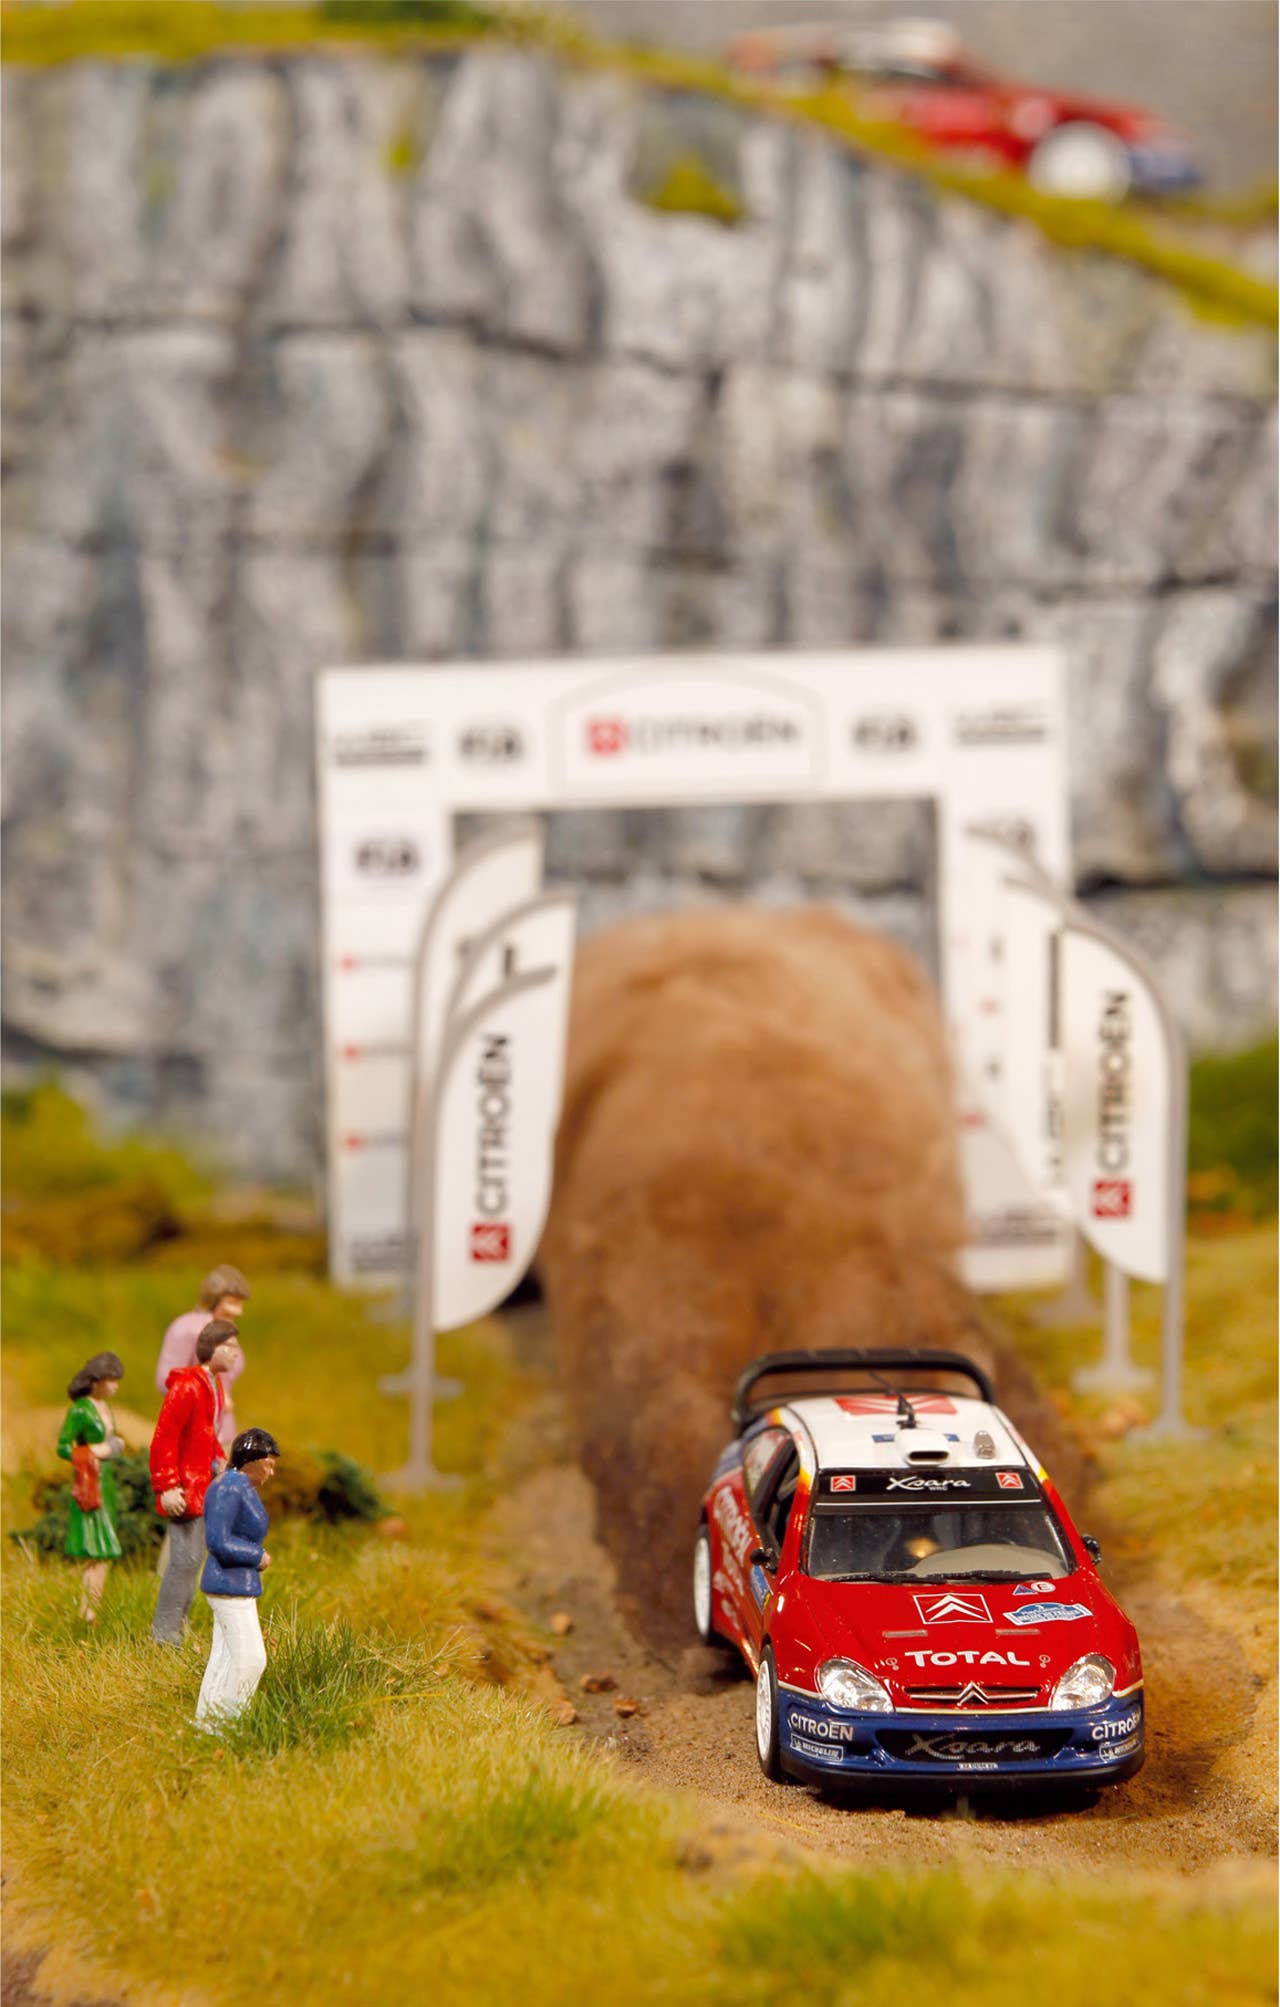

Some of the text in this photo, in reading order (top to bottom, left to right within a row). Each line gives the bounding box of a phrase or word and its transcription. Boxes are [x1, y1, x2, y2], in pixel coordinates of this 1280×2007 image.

[886, 1476, 971, 1491] Xsara
[904, 1650, 1031, 1667] TOTAL
[904, 1733, 1040, 1760] Xsara
